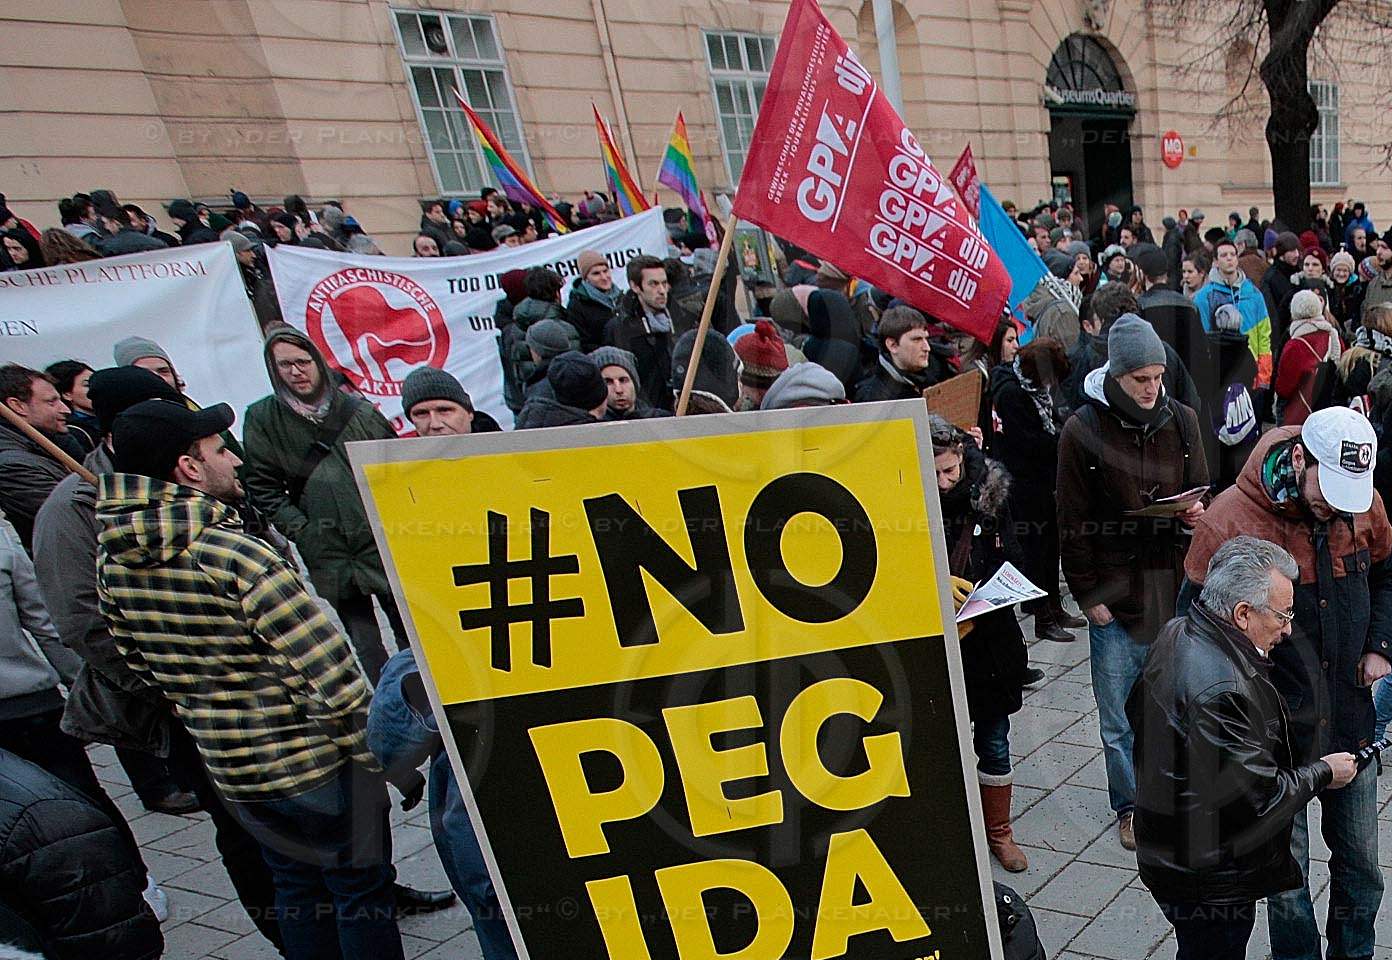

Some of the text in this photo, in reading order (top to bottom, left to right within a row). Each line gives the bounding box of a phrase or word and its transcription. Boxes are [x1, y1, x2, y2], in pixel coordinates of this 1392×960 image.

[773, 171, 790, 205] DRUCK
[63, 260, 208, 286] PLATTFORM
[447, 278, 481, 294] TOD
[450, 471, 879, 673] #NO
[527, 676, 912, 860] PEG
